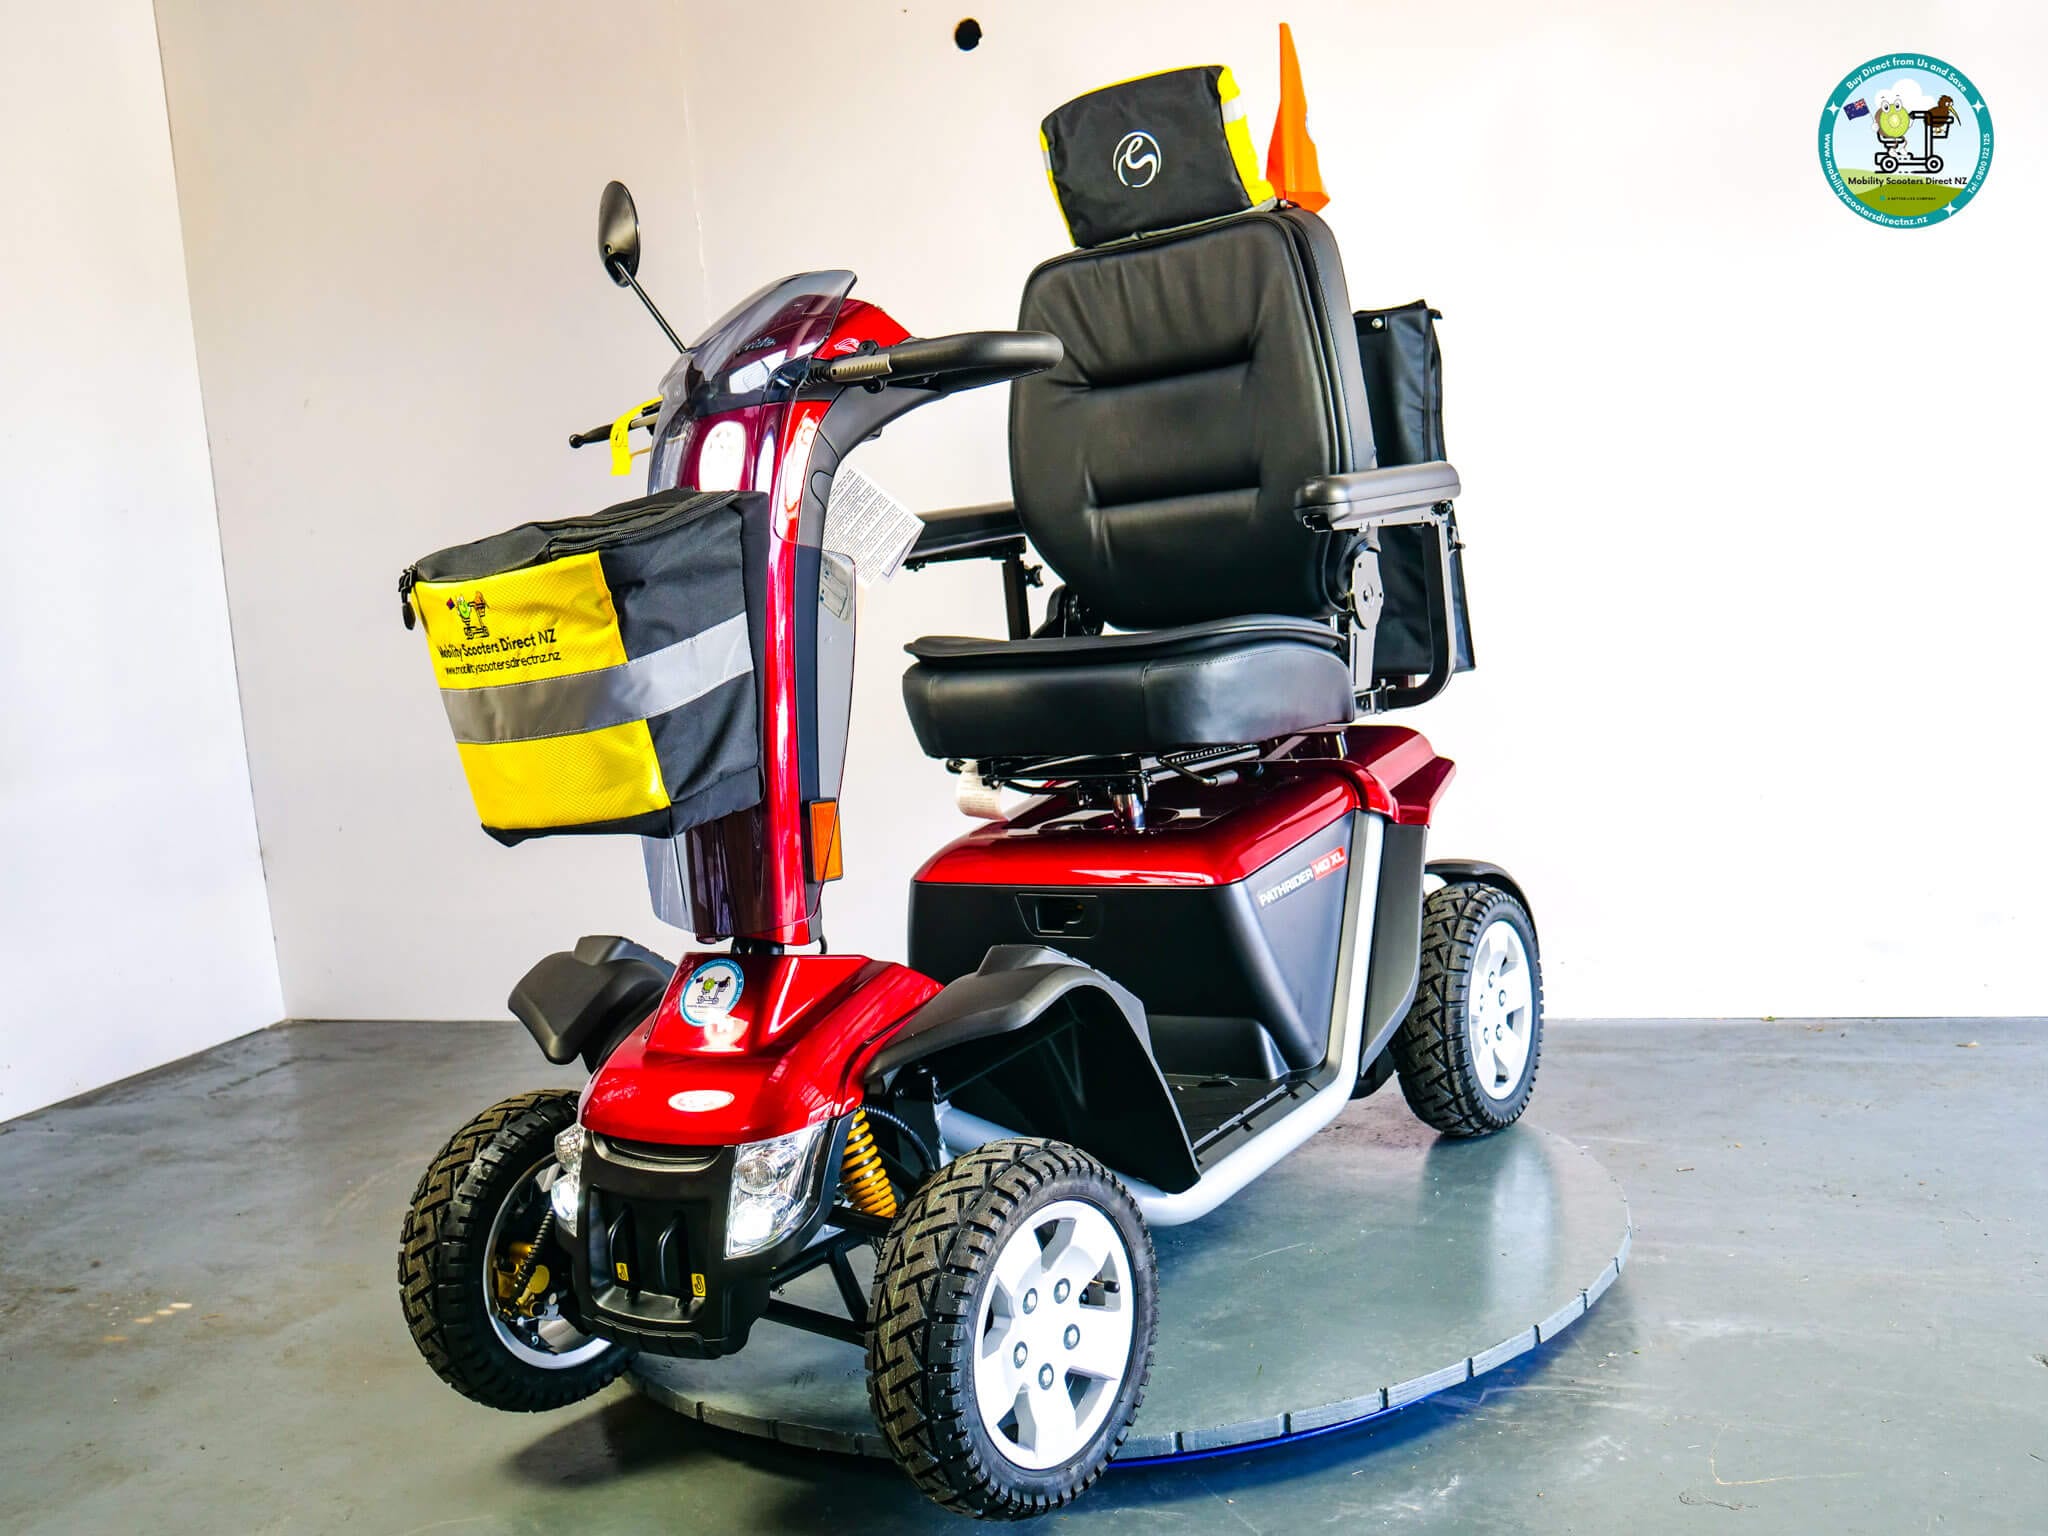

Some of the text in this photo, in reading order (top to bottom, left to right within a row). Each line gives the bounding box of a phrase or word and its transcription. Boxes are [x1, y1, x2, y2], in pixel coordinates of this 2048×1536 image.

[438, 628, 557, 662] Mobility Scooters Direct NZ
[1258, 868, 1314, 907] PATHRIDER
[1331, 851, 1345, 865] XL
